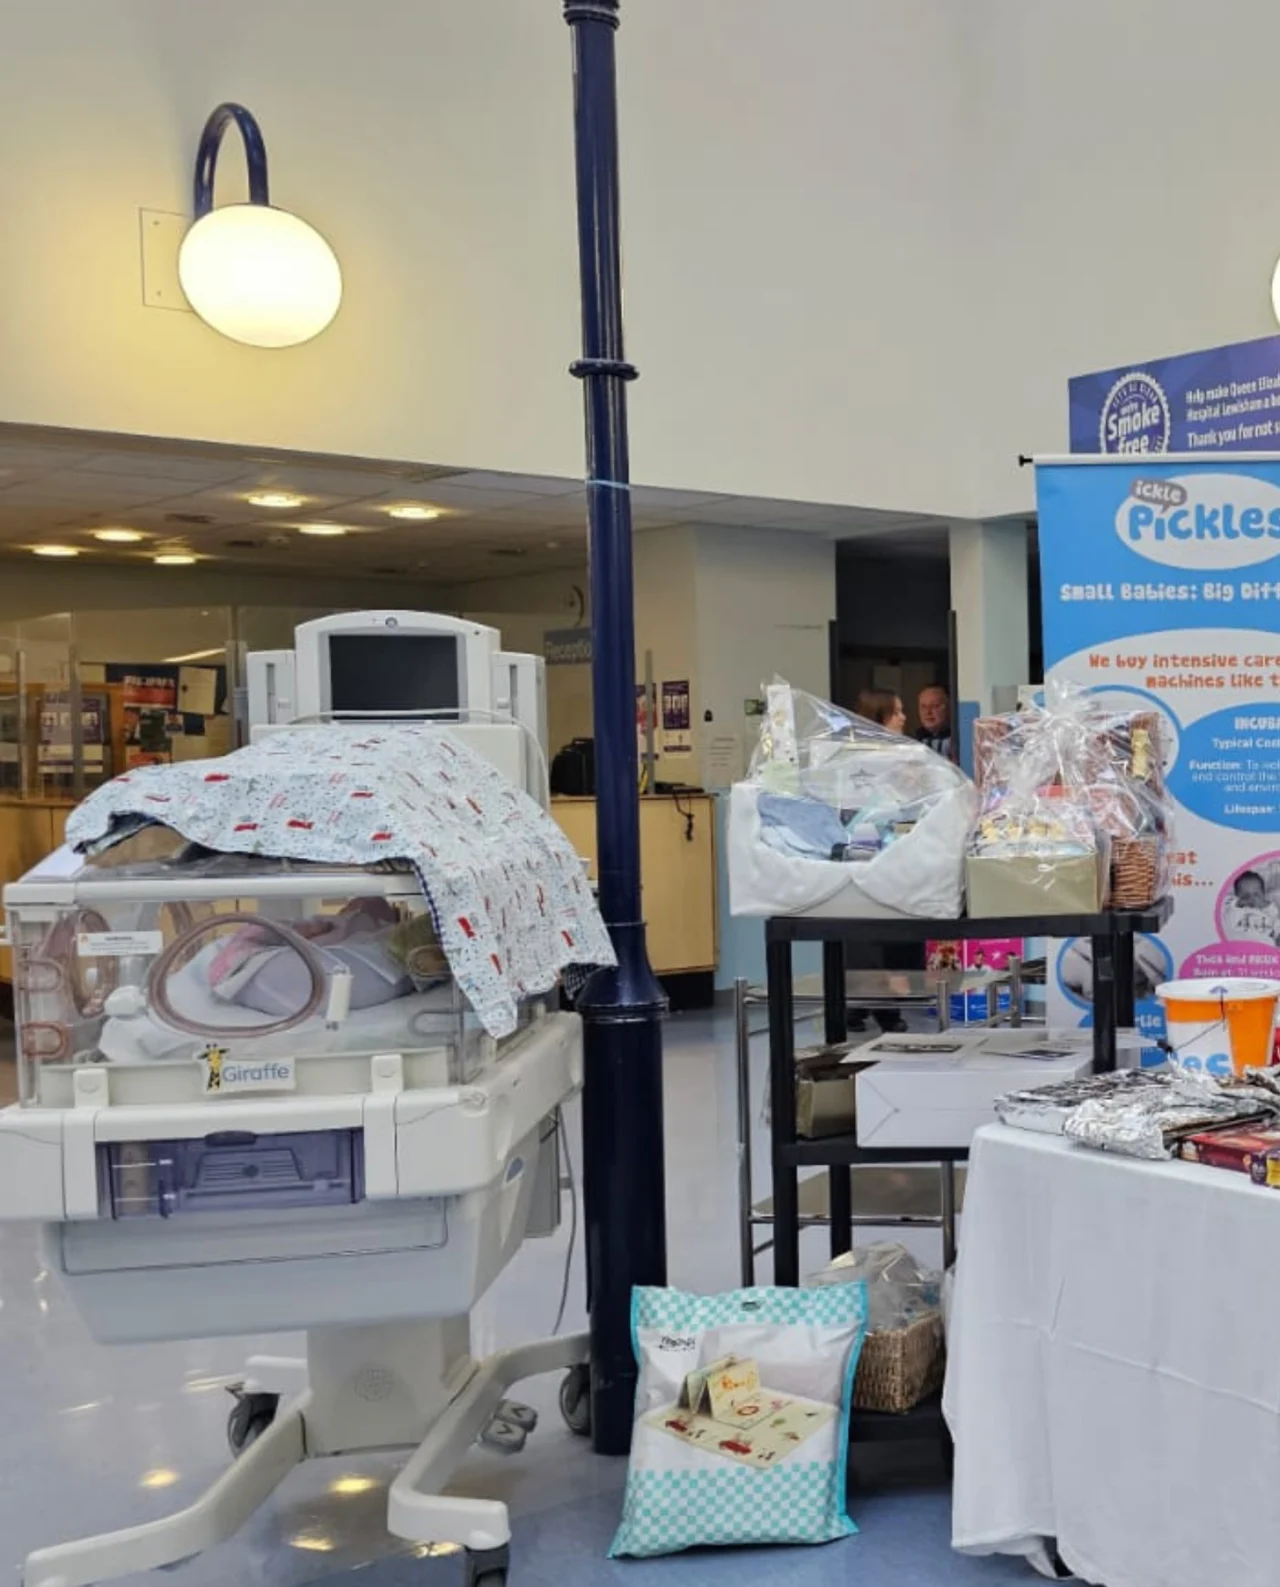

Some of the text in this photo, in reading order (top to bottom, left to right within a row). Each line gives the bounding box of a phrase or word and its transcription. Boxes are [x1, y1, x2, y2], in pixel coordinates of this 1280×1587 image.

[1206, 385, 1229, 400] make
[1230, 381, 1257, 399] Queen
[1186, 404, 1221, 423] Hospital
[1222, 397, 1263, 417] Lewisham
[1107, 401, 1160, 441] Smoke
[1118, 434, 1150, 454] free
[1187, 429, 1217, 448] Thank
[1218, 429, 1237, 446] you
[1238, 423, 1253, 440] for
[1255, 420, 1273, 437] not
[1134, 479, 1182, 502] ickle
[1059, 582, 1115, 602] Small
[1120, 582, 1198, 601] Babies:
[1203, 582, 1235, 602] Big
[1088, 653, 1110, 669] We
[1116, 653, 1147, 670] buy
[1152, 653, 1239, 668] intensive
[1144, 673, 1225, 689] machines
[1230, 673, 1267, 688] like
[1212, 737, 1253, 750] Typical
[1191, 771, 1213, 782] and
[1224, 782, 1246, 793] and
[222, 1062, 290, 1085] Giraffe
